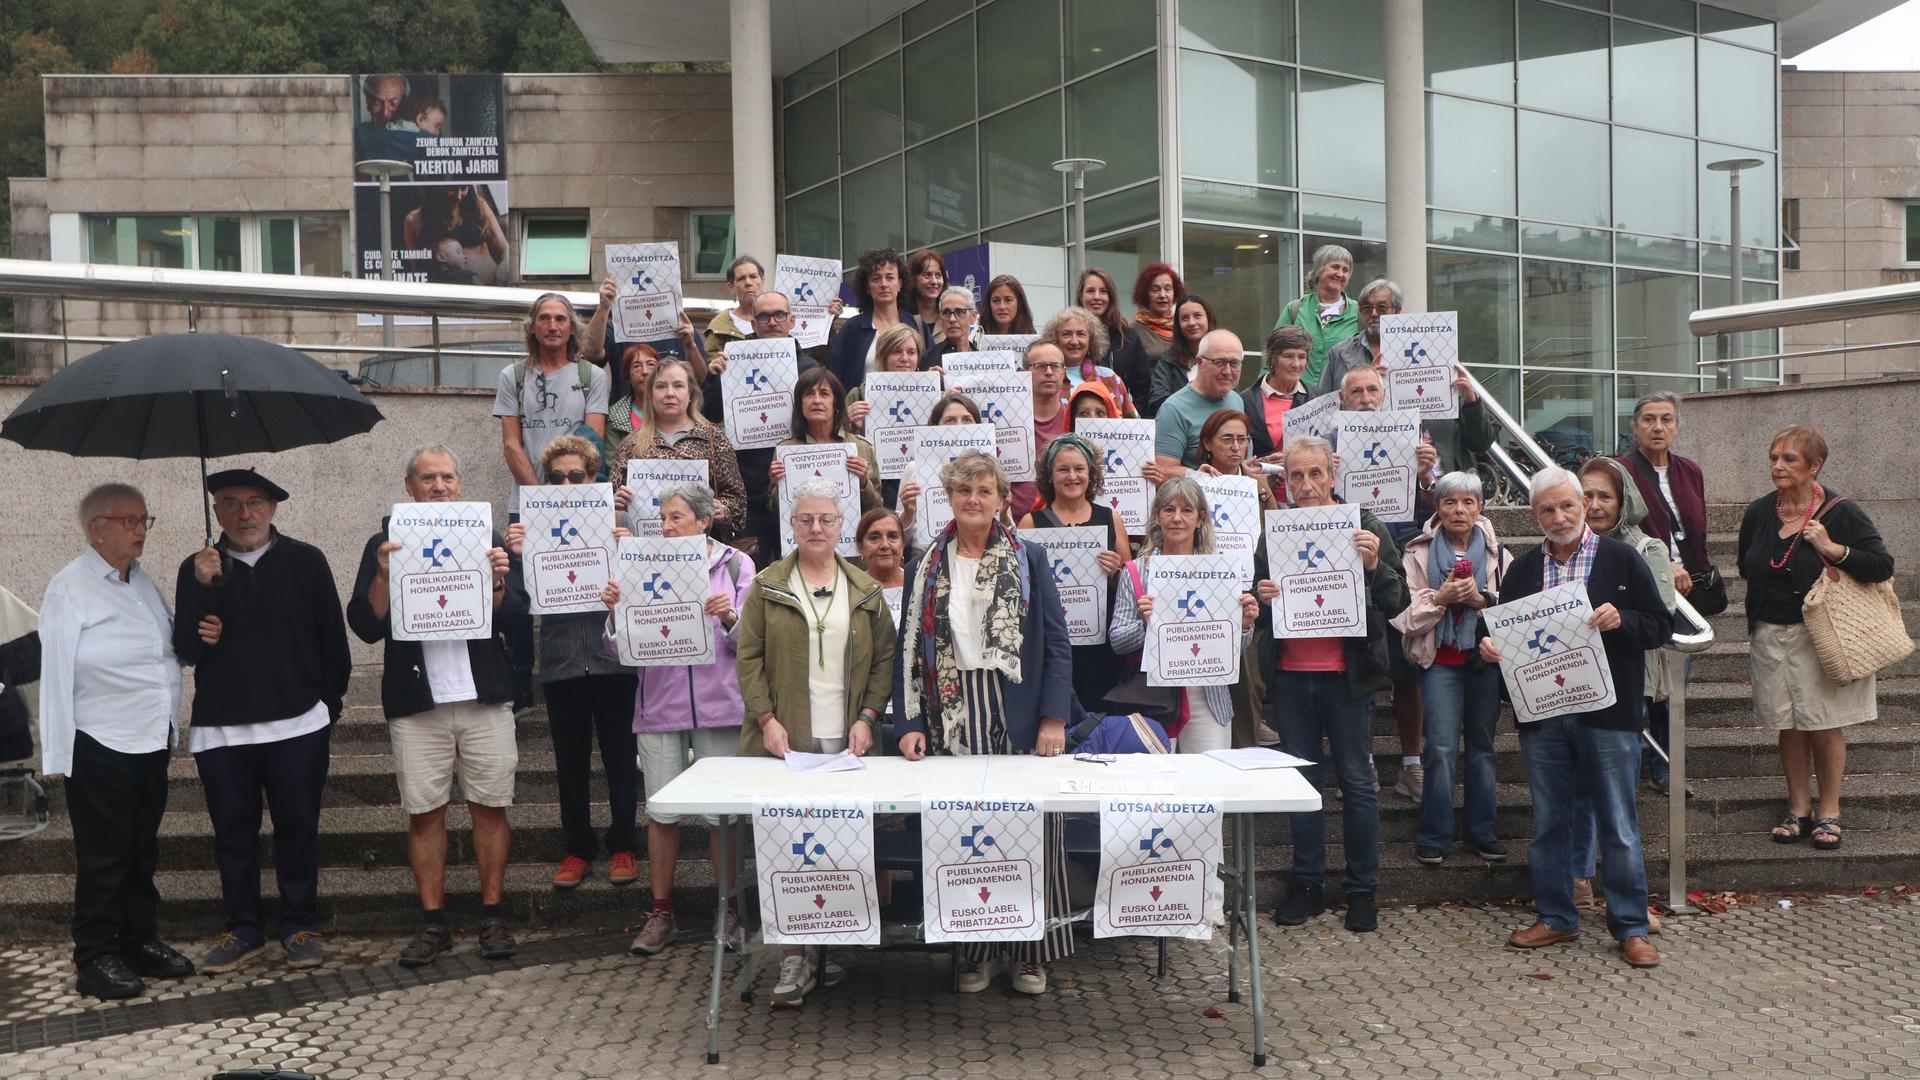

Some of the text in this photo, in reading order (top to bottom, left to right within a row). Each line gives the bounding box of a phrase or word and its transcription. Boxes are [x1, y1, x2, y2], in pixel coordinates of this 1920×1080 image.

[416, 137, 498, 147] ZEURE BURUA ZAINTZEA
[426, 147, 450, 156] DENOK
[451, 147, 484, 156] ZAINTZEA
[414, 159, 498, 174] TXERTOA JARRI
[401, 248, 432, 259] TAMBIÉN
[365, 260, 373, 269] ES
[781, 266, 837, 277] LOTSAKIDETZA
[625, 296, 667, 304] PUBLIKOAREN
[625, 301, 670, 311] HONDAMENDIA
[629, 325, 673, 334] PRIBATIZAZIOA
[728, 352, 791, 360] OTSAKIDETZA
[1396, 369, 1441, 378] PUBLIKOAREN
[1396, 376, 1444, 384] HONDAMENDIA
[960, 386, 1027, 394] LOTSAKIDETZA
[738, 395, 784, 406] PUBLIKOAREN
[739, 402, 787, 414] HONDAMENDIA
[1287, 401, 1336, 427] LOTSAKIDETZA
[743, 426, 765, 434] EUSKO
[1344, 424, 1415, 433] LOTSAKIDETZA
[743, 430, 790, 441] PRIBATIZAZIOA
[920, 440, 992, 448] LOTSAKIDETZA
[632, 473, 703, 481] LOTSAKIDETZA
[1352, 470, 1400, 480] PUBLIKOAREN
[1352, 476, 1402, 488] HONDAMENDIA
[526, 500, 608, 509] LOTSAKIDETZA
[397, 518, 485, 528] LOTSAKIDETZA
[1272, 522, 1354, 533] LOTSAKIDETZA
[542, 552, 597, 563] PUBLIKOAREN
[621, 553, 702, 562] LOTSAKIDETZA
[542, 560, 601, 571] HONDAMENDIA
[410, 575, 471, 585] PUBLIKOAREN
[1155, 570, 1236, 580] LOTSAKIDETZA
[1290, 574, 1344, 586] PUBLIKOAREN
[410, 583, 474, 594] HONDAMENDIA
[546, 584, 599, 596] EUSKO LABEL
[1290, 583, 1348, 594] HONDAMENDIA
[414, 610, 472, 621] EUSKO LABEL
[634, 606, 691, 616] PUBLIKOAREN
[1294, 608, 1347, 619] EUSKO LABEL
[1495, 599, 1583, 629] LOTSAKIDETZA
[412, 619, 475, 630] PRIBATIZAZIOA
[634, 614, 695, 625] HONDAMENDIA
[1293, 617, 1350, 628] PRIBATIZAZIOA
[1166, 624, 1222, 634] PUBLIKOAREN
[1166, 633, 1225, 642] HONDAMENDIA
[639, 638, 694, 649] EUSKO LABEL
[638, 646, 698, 657] PRIBATIZAZIOA
[1523, 651, 1583, 675] PUBLIKOAREN
[1167, 666, 1225, 676] PRIBATIZAZIOA
[1525, 659, 1589, 683] HONDAMENDIA
[1535, 684, 1593, 704] EUSKO LABEL
[1536, 691, 1598, 712] PRIBATIZAZIOA
[930, 800, 1035, 812] LOTSAKIDETZA
[1110, 802, 1215, 814] LOTSAKIDETZA
[762, 808, 864, 819] LOTSAKIDETZA
[947, 864, 1018, 877] PUBLIKOAREN
[1122, 864, 1192, 877] PUBLIKOAREN
[781, 874, 850, 884] PUBLIKOAREN
[947, 874, 1022, 887] HONDAMENDIA
[1121, 874, 1195, 886] HONDAMENDIA
[782, 884, 855, 894] HONDAMENDIA
[951, 904, 1019, 917] EUSKO LABEL
[1121, 905, 1155, 913] EUSKO
[788, 910, 855, 922] EUSKO LABEL
[1118, 913, 1192, 923] PRIBATIZAZIOA
[787, 919, 860, 931] PRIBATIZAZIOA
[950, 916, 1023, 928] PRIBATIZAZIOA
